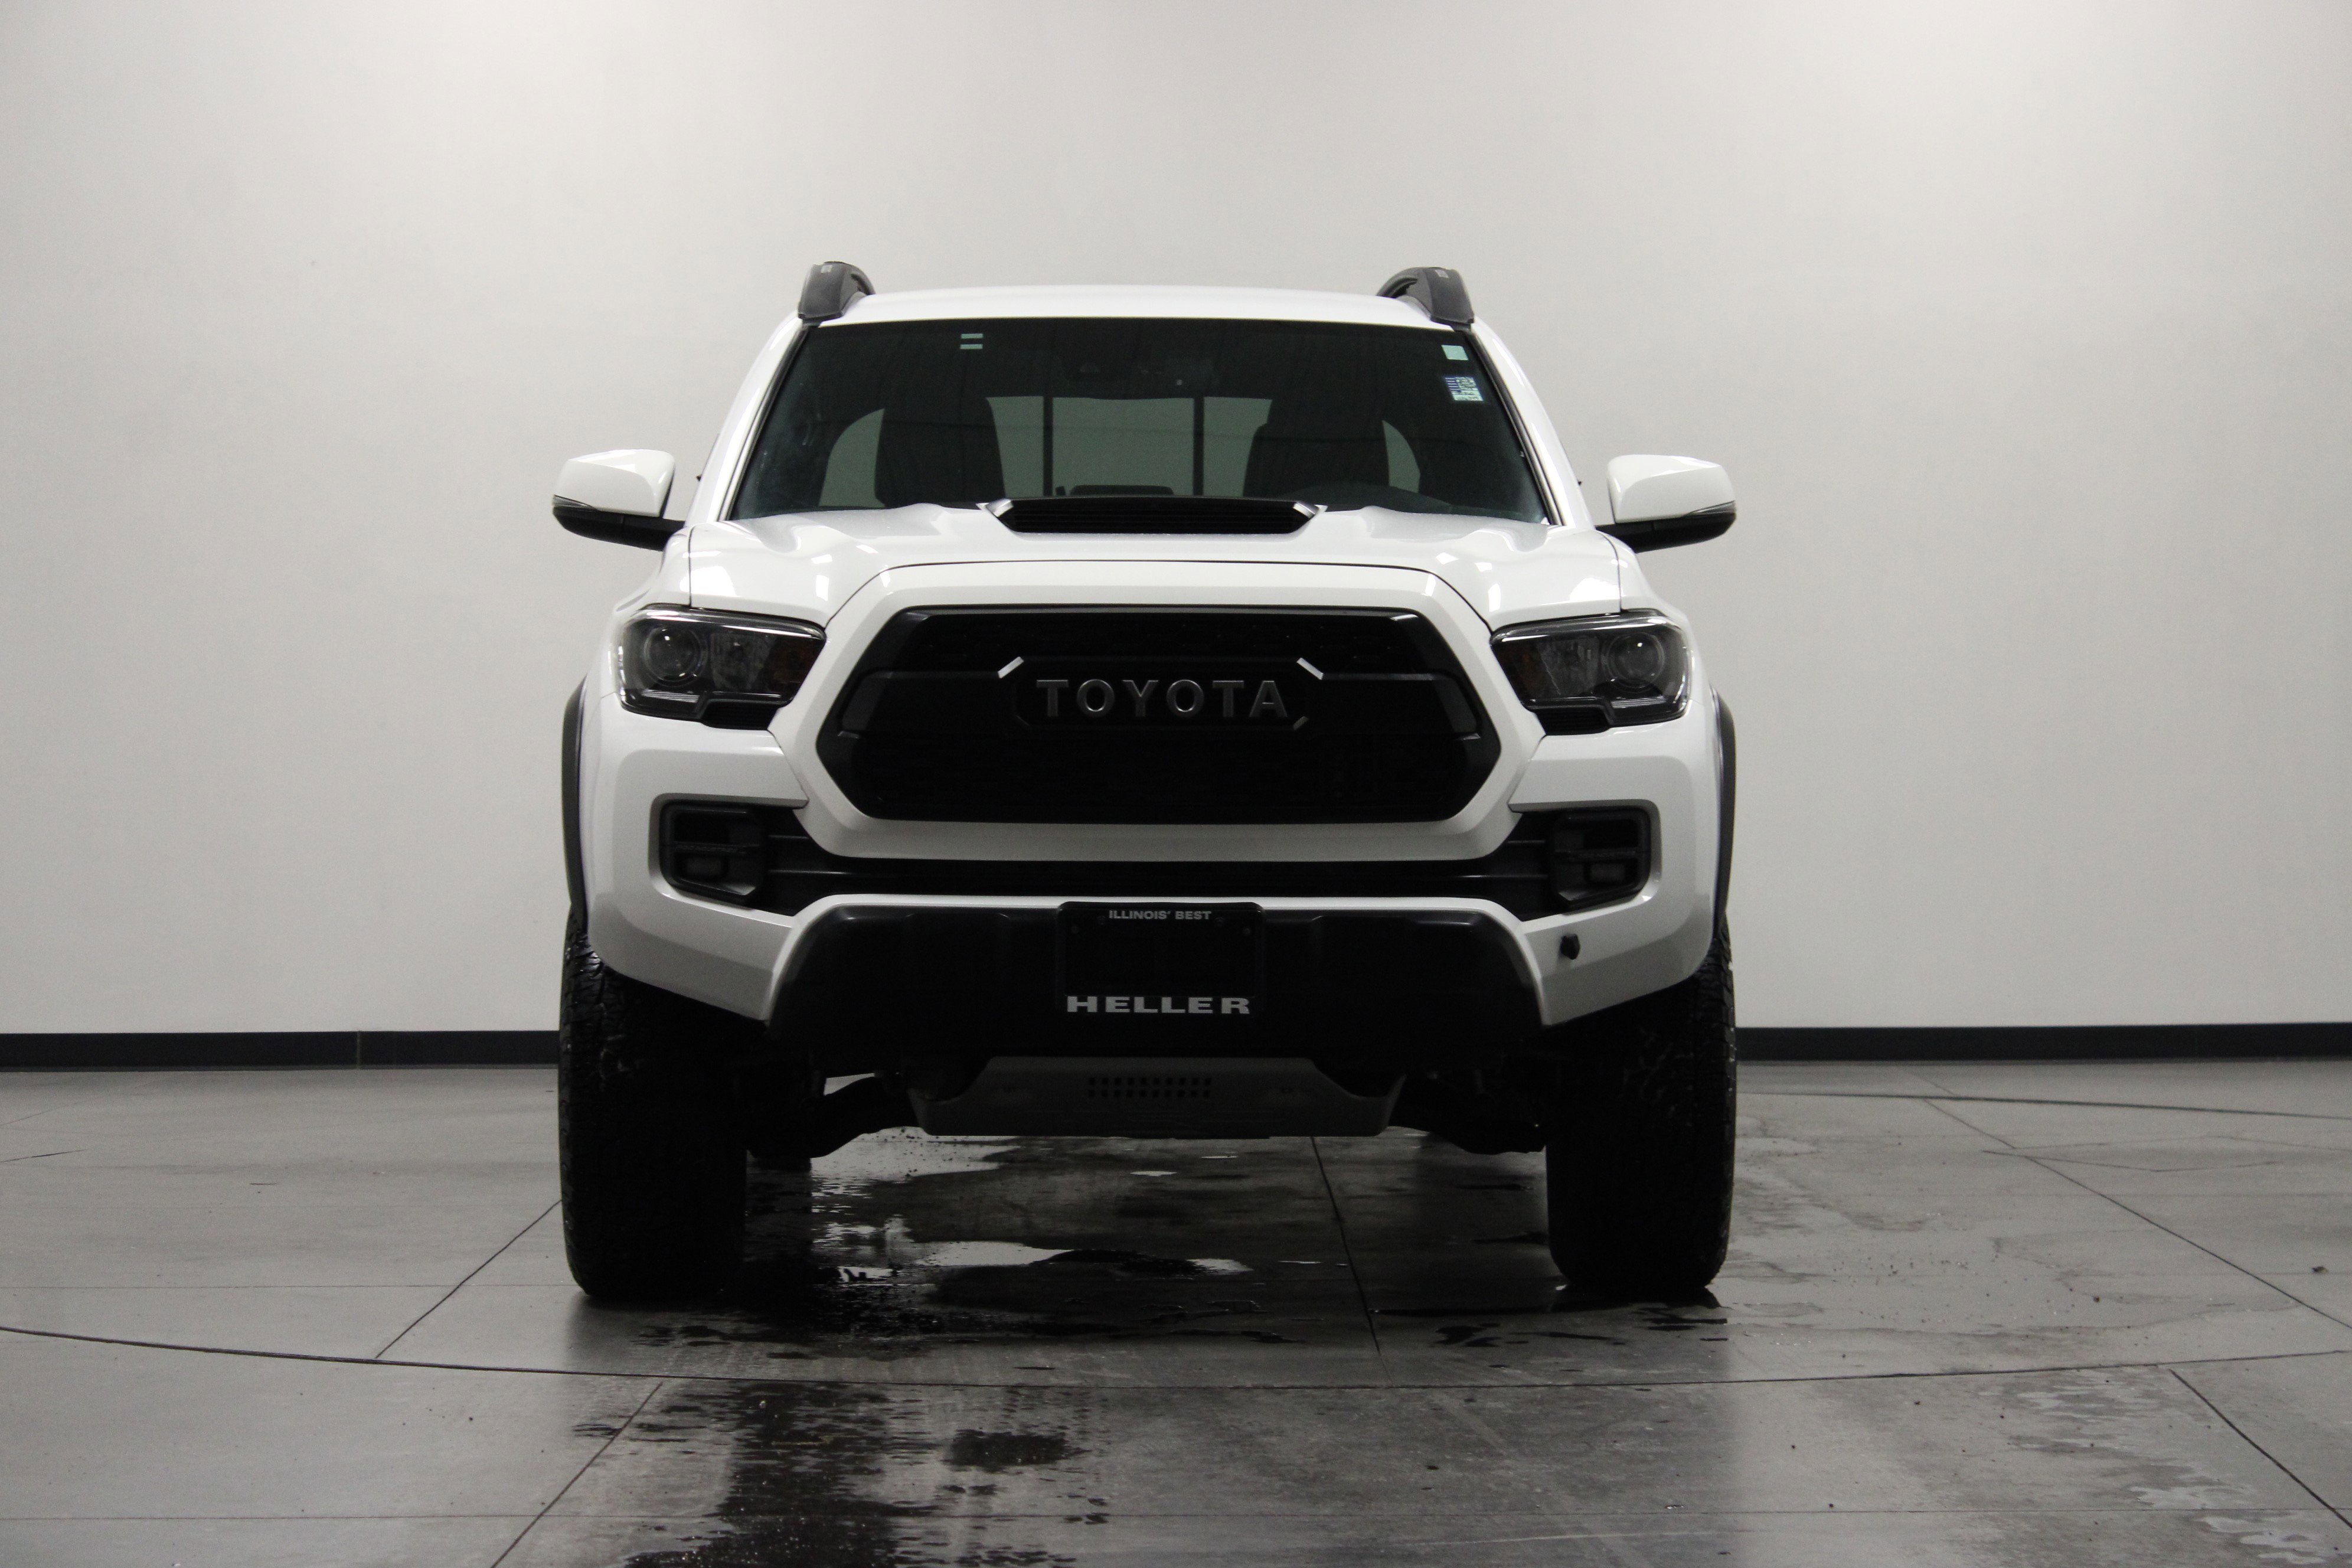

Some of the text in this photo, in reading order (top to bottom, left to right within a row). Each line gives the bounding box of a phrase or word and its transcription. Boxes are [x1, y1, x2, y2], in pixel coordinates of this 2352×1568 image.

[1036, 678, 1288, 718] TOYOTA
[1108, 910, 1212, 920] ILLINOIS' BEST
[1067, 996, 1250, 1014] HELLER
